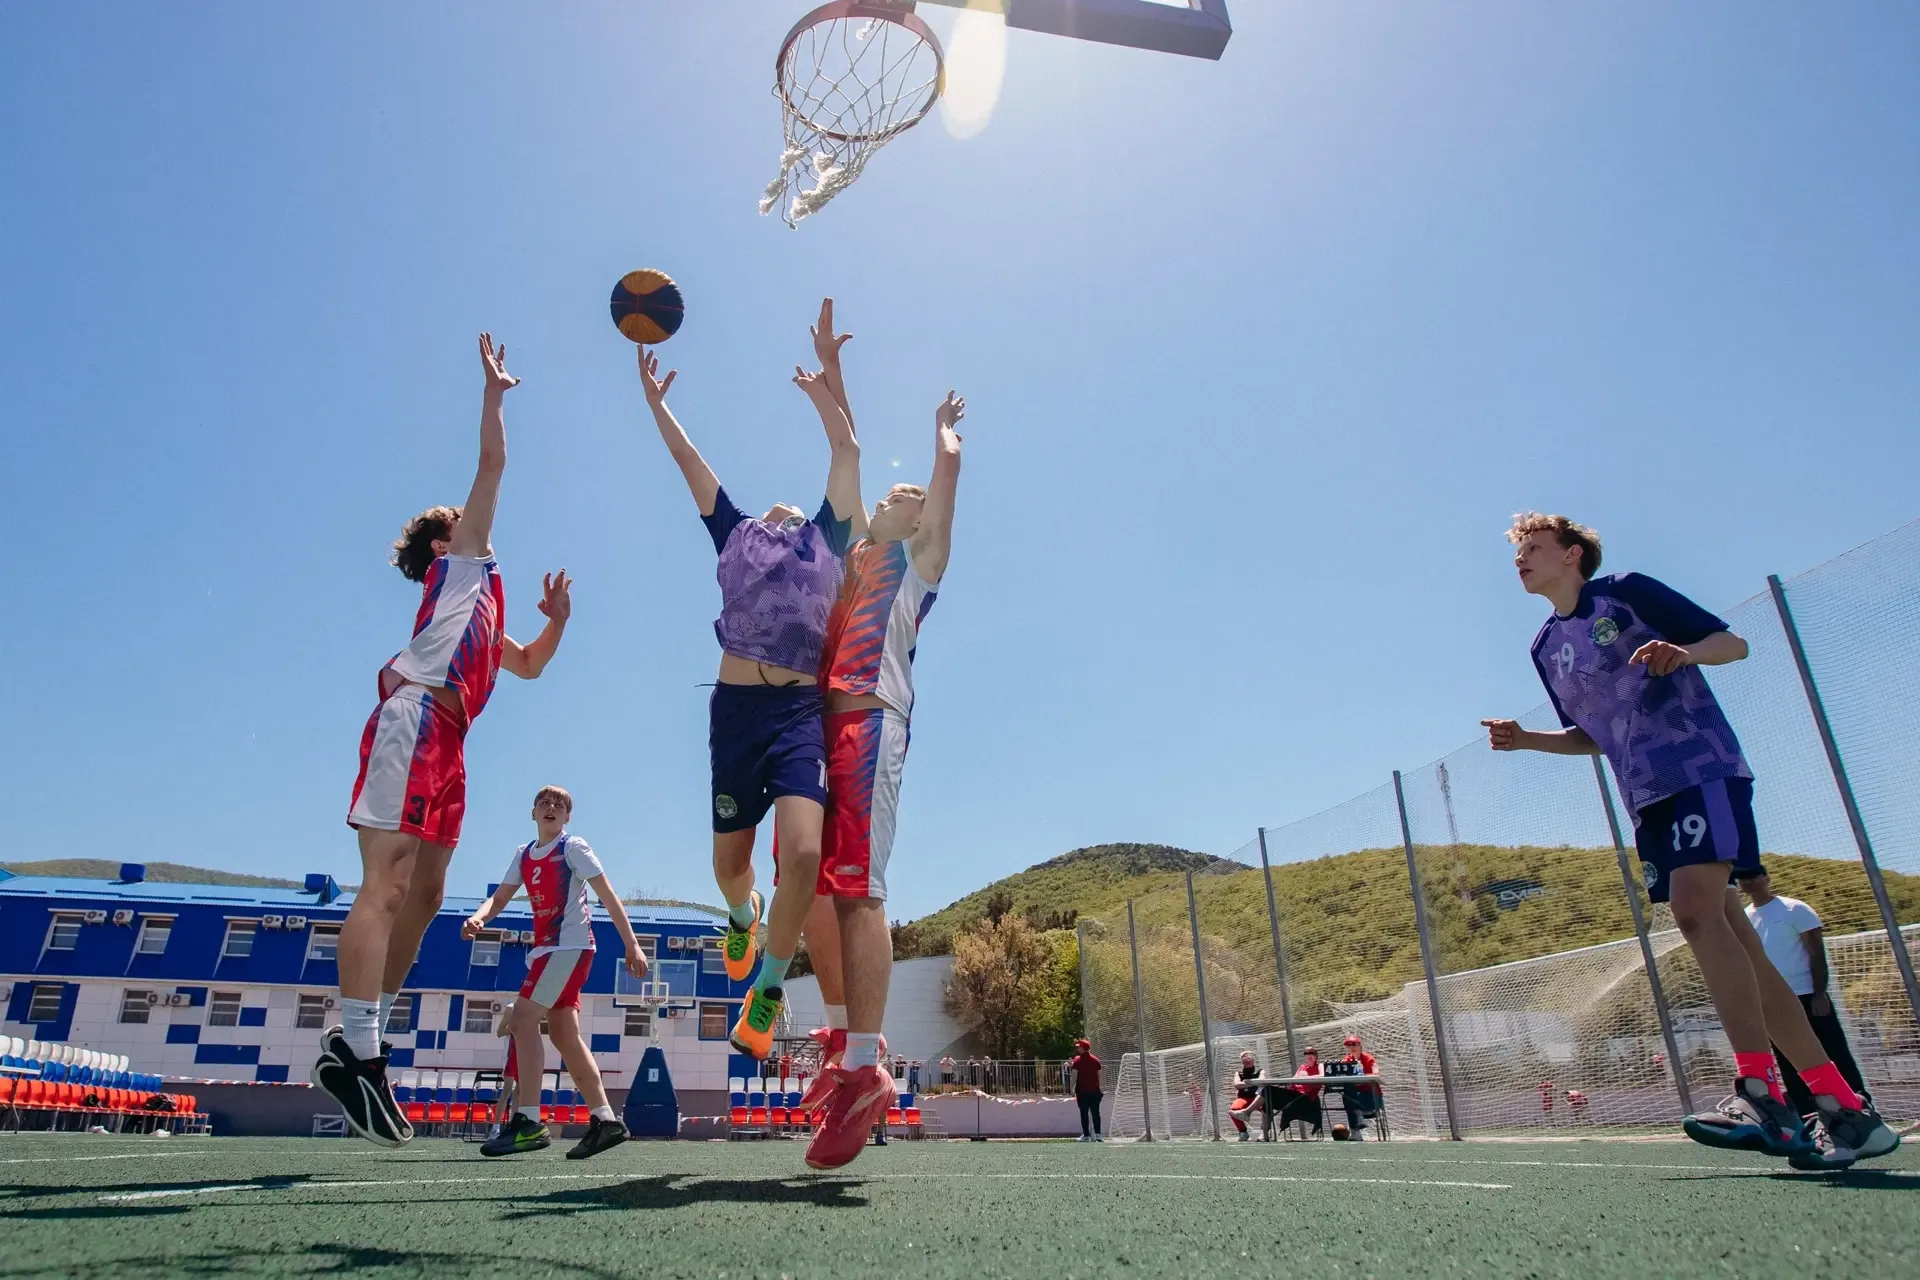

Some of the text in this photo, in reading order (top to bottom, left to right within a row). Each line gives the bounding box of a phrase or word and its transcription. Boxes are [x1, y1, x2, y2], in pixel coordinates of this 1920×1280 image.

[1550, 642, 1575, 679] 19
[407, 795, 425, 825] 3
[1671, 814, 1707, 852] 19
[531, 866, 542, 885] 2
[1325, 1064, 1333, 1074] 4
